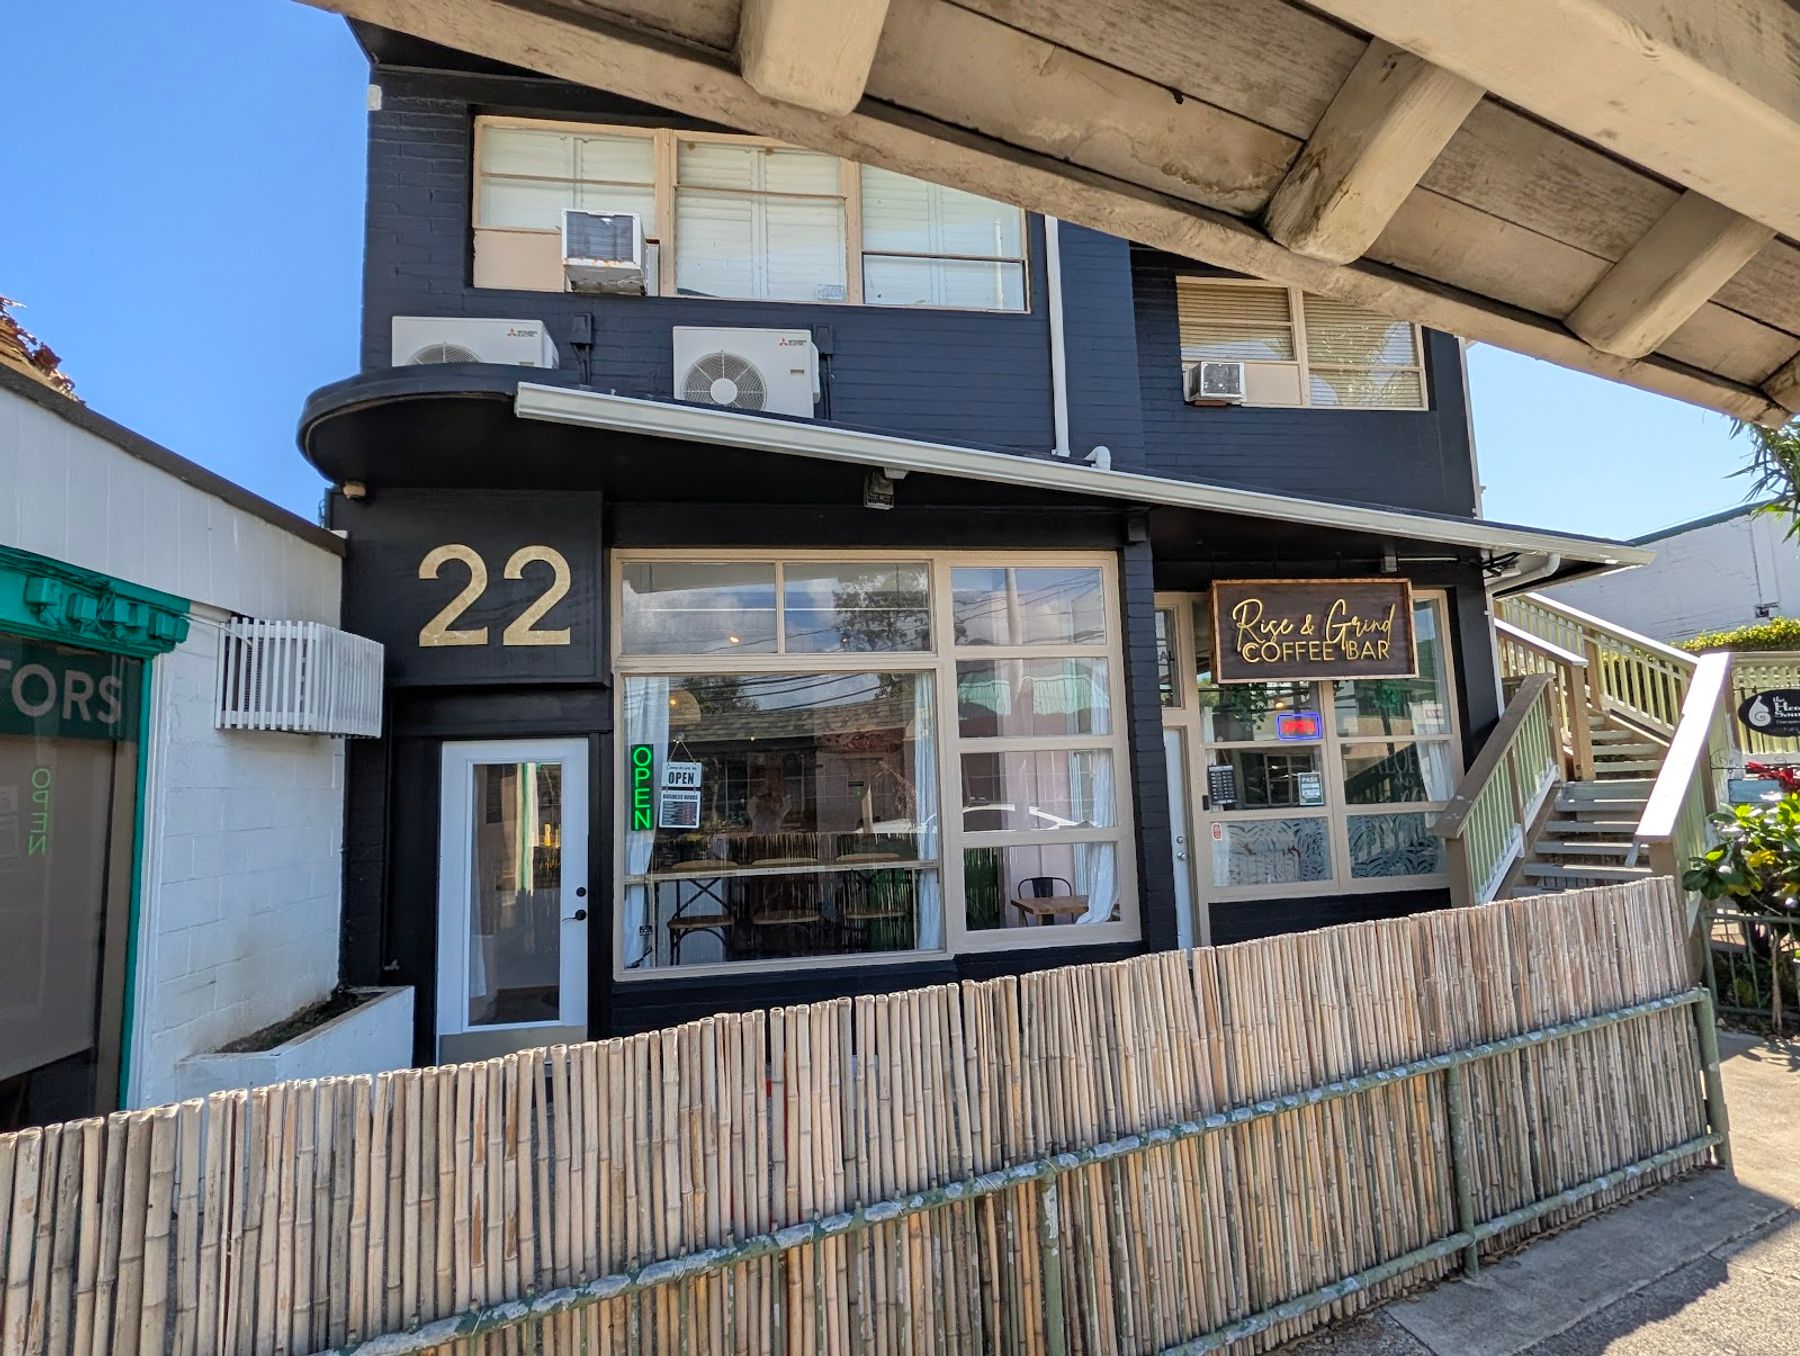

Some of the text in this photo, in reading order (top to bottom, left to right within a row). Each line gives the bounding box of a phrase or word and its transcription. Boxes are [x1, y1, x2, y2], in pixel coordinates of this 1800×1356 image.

[418, 543, 571, 647] 22
[1232, 598, 1396, 652] Rise & Grind
[1242, 640, 1390, 663] COFFEE BAR
[633, 747, 652, 831] OPEN
[668, 771, 695, 785] OPEN
